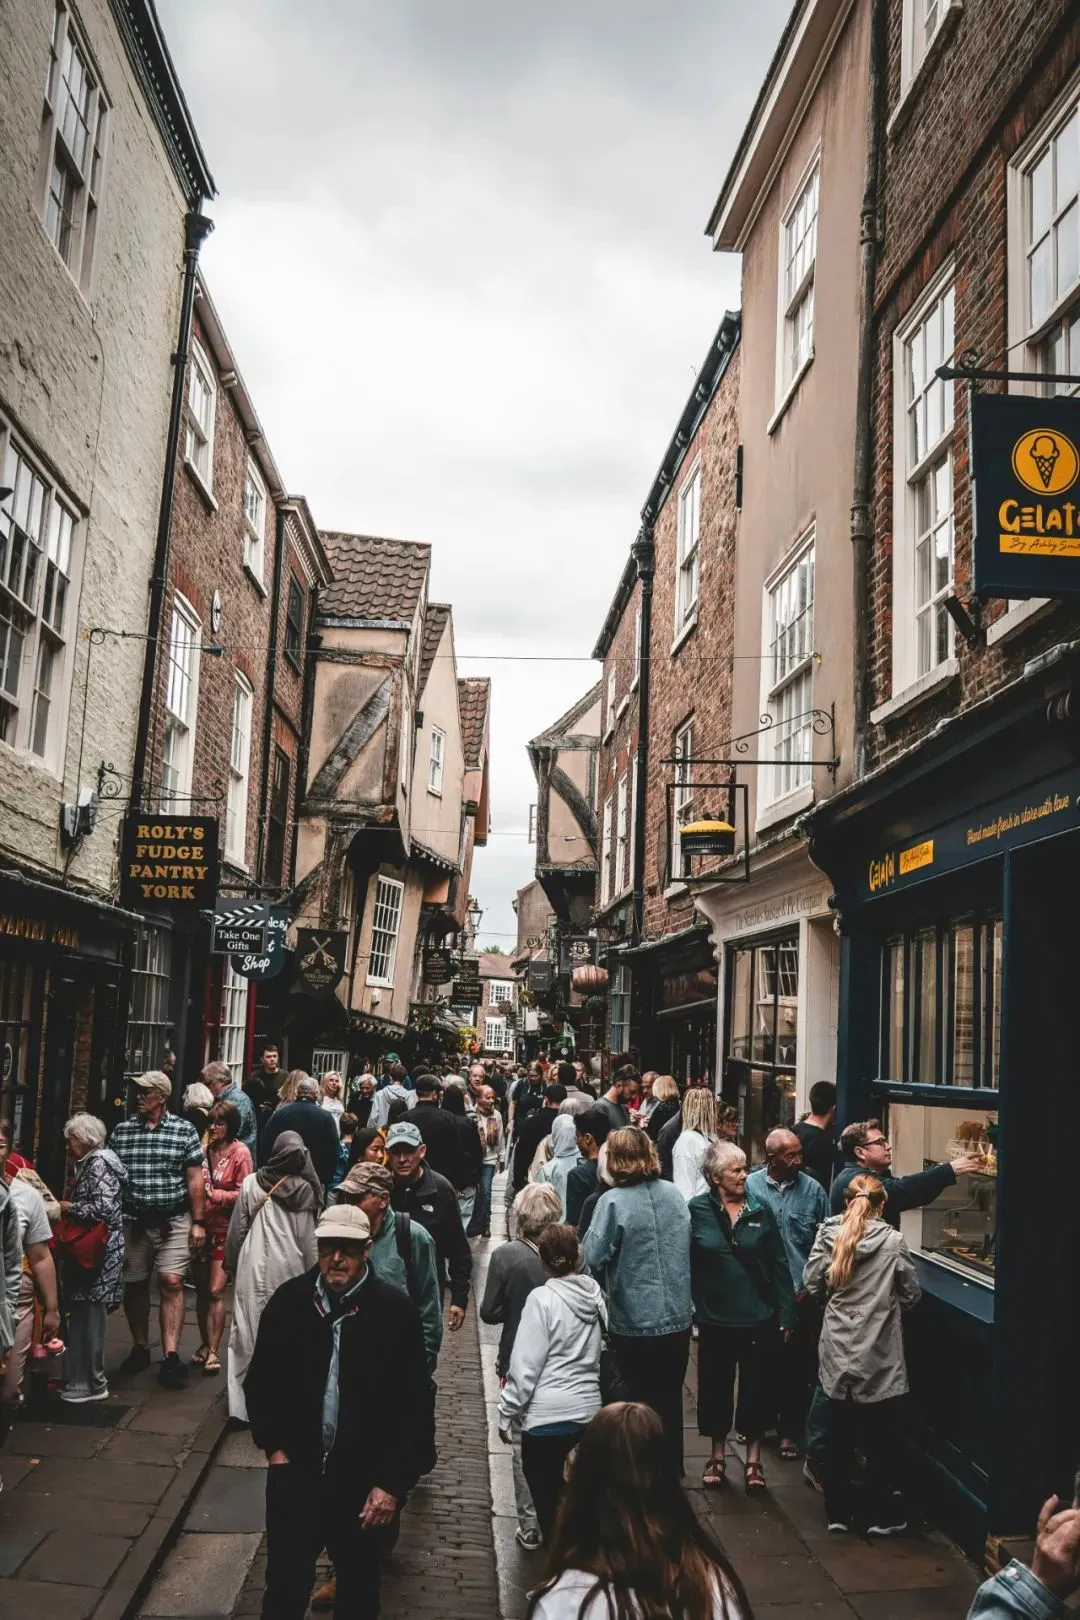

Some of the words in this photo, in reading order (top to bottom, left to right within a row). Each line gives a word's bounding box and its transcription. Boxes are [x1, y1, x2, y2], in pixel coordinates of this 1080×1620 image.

[998, 499, 1080, 536] GELAT
[1009, 537, 1026, 551] By
[1053, 793, 1069, 812] love
[137, 825, 205, 840] ROLY'S
[136, 844, 204, 860] FUDGE
[129, 864, 208, 880] PANTRY
[141, 884, 196, 899] YORK
[217, 929, 240, 939] Take
[241, 931, 260, 941] One
[227, 941, 249, 950] Gifts
[241, 955, 271, 973] Shop
